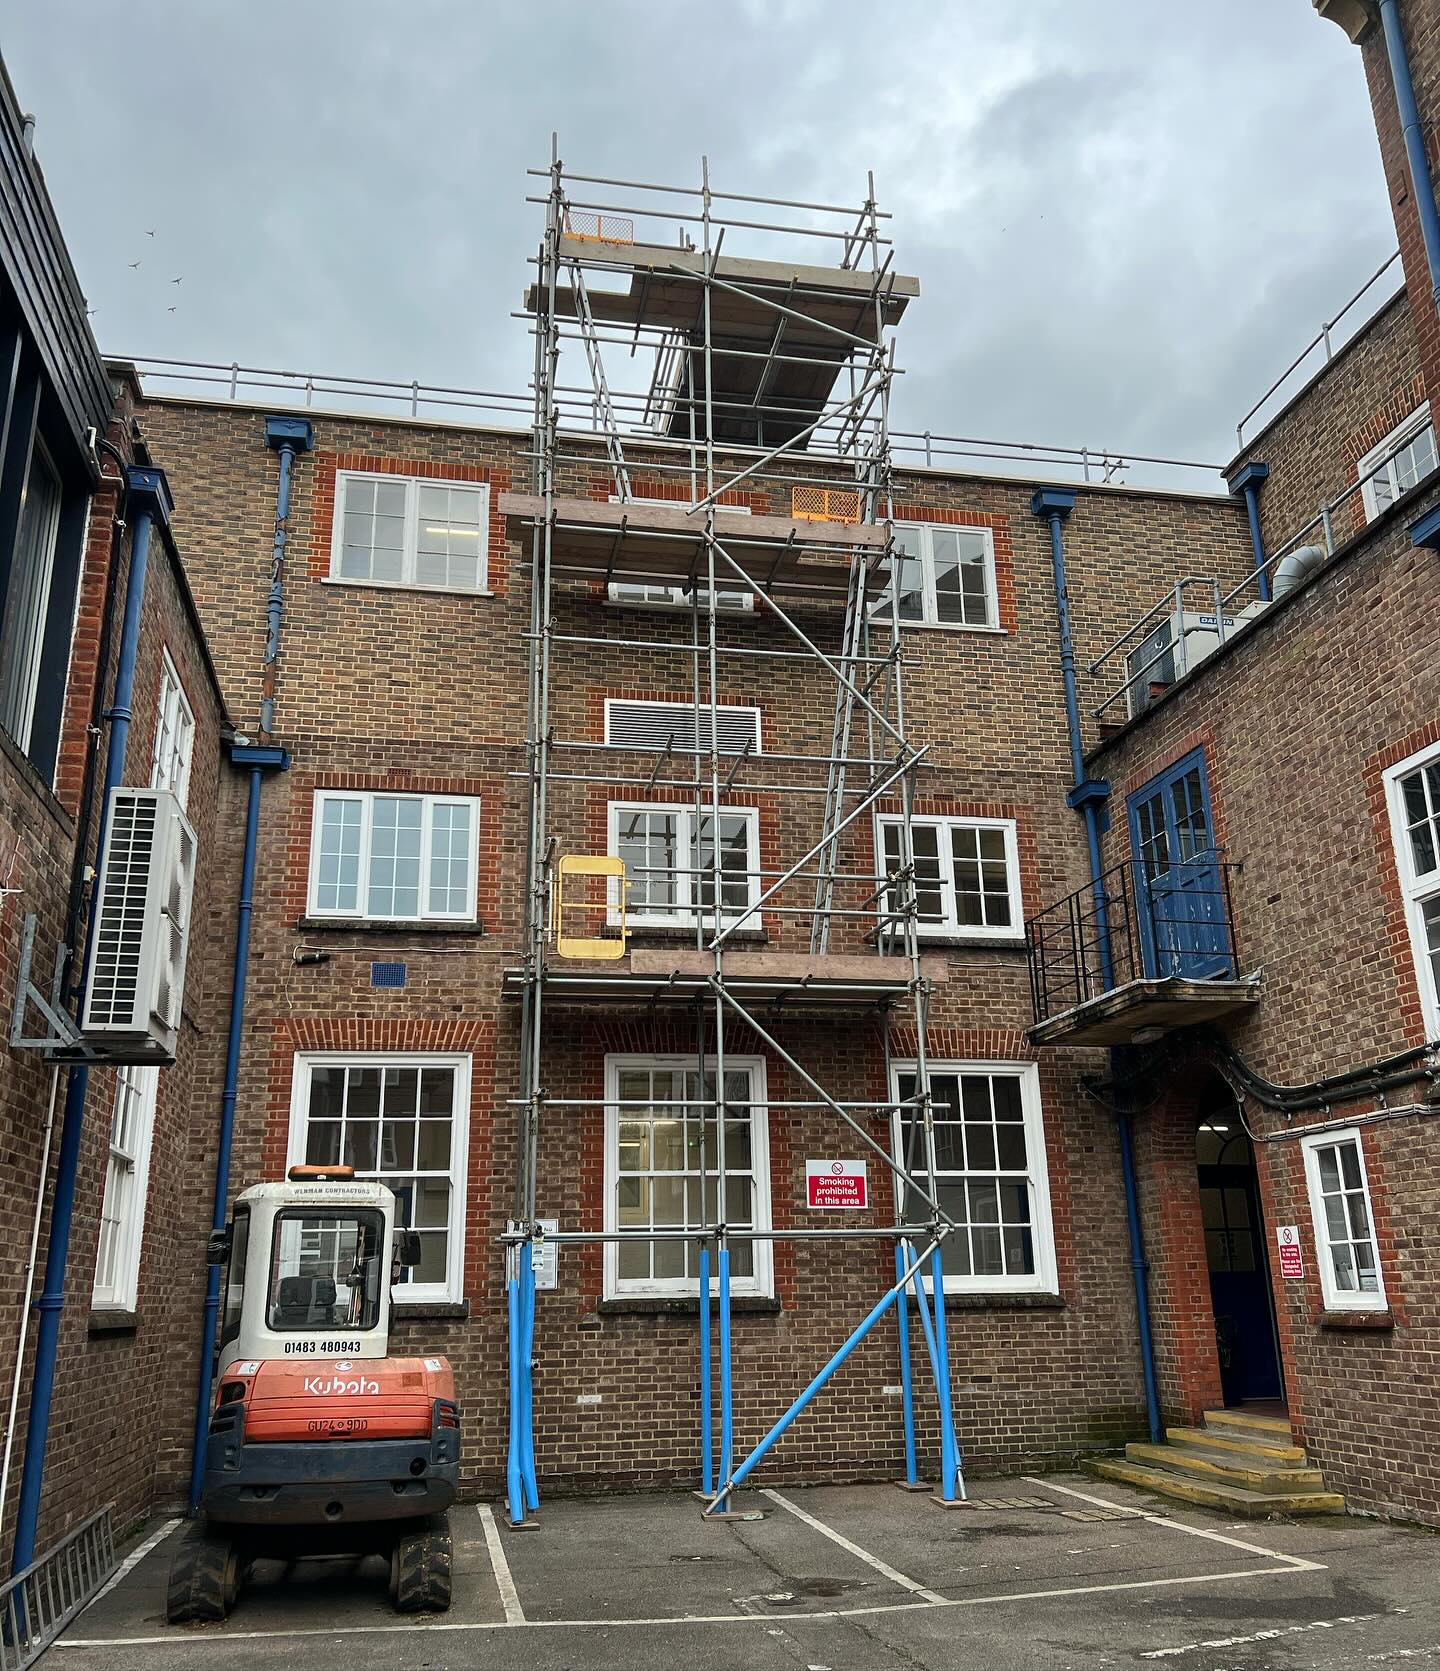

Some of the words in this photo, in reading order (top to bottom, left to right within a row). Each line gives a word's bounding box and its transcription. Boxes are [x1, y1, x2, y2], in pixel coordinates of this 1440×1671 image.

[1201, 617, 1233, 625] DAIIN
[819, 1177, 855, 1187] Smoking
[816, 1187, 858, 1196] prohibited
[815, 1196, 823, 1205] in
[825, 1196, 840, 1205] this
[284, 1342, 316, 1353] 01483
[320, 1341, 361, 1352] 480943
[304, 1376, 379, 1395] Kubota
